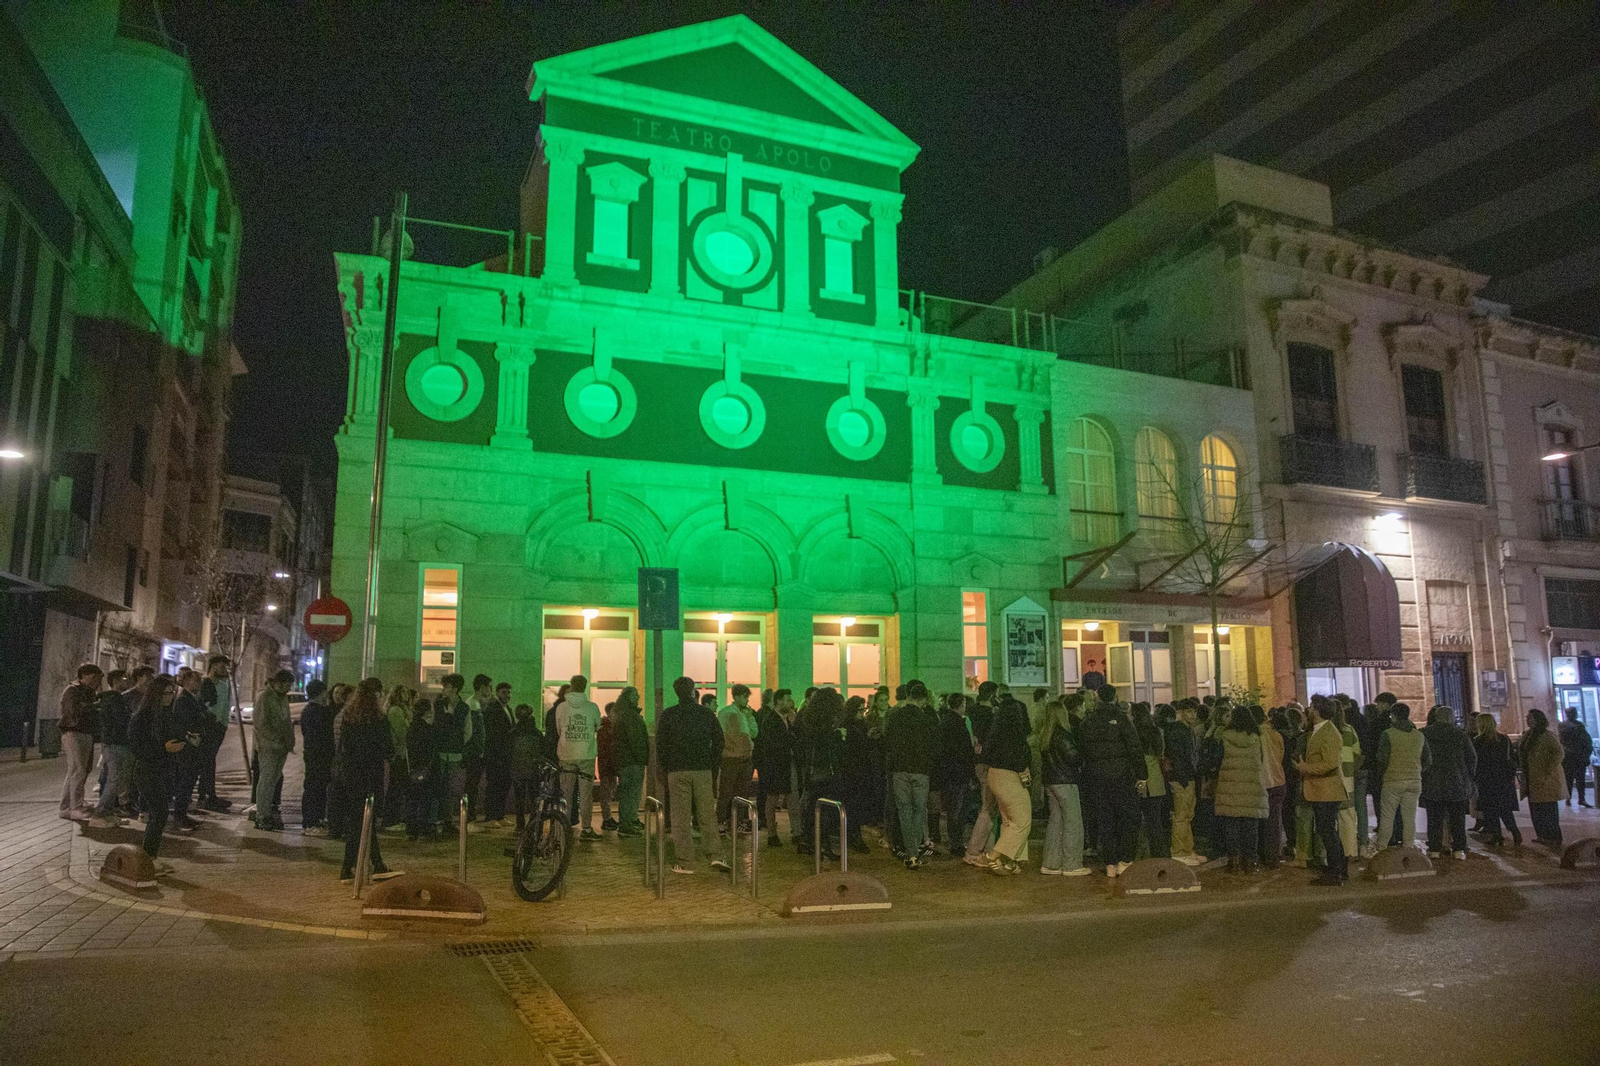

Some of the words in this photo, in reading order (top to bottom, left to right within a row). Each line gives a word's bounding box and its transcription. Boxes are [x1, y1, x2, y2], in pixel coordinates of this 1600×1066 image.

[632, 117, 732, 152] TEATRO
[755, 142, 832, 173] APOLO
[1349, 659, 1389, 668] ROBERTO
